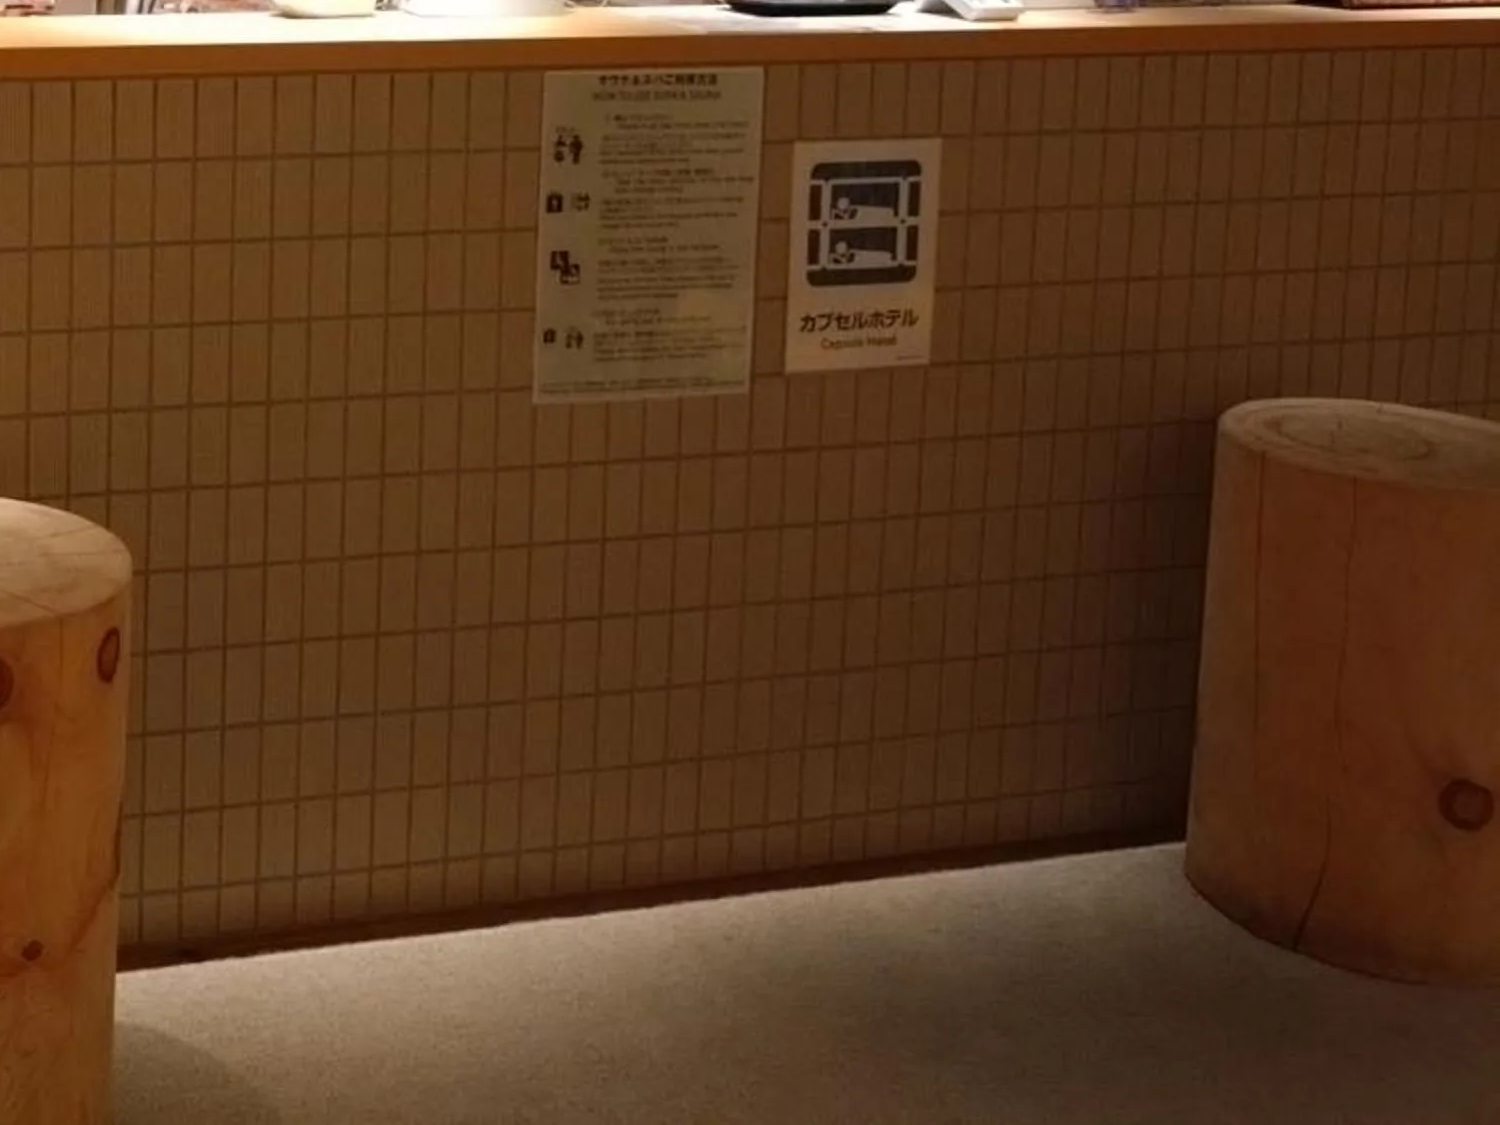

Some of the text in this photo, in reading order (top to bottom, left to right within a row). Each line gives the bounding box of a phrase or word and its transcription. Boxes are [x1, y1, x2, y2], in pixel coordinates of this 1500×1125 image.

[800, 308, 920, 333] カプセルホテル
